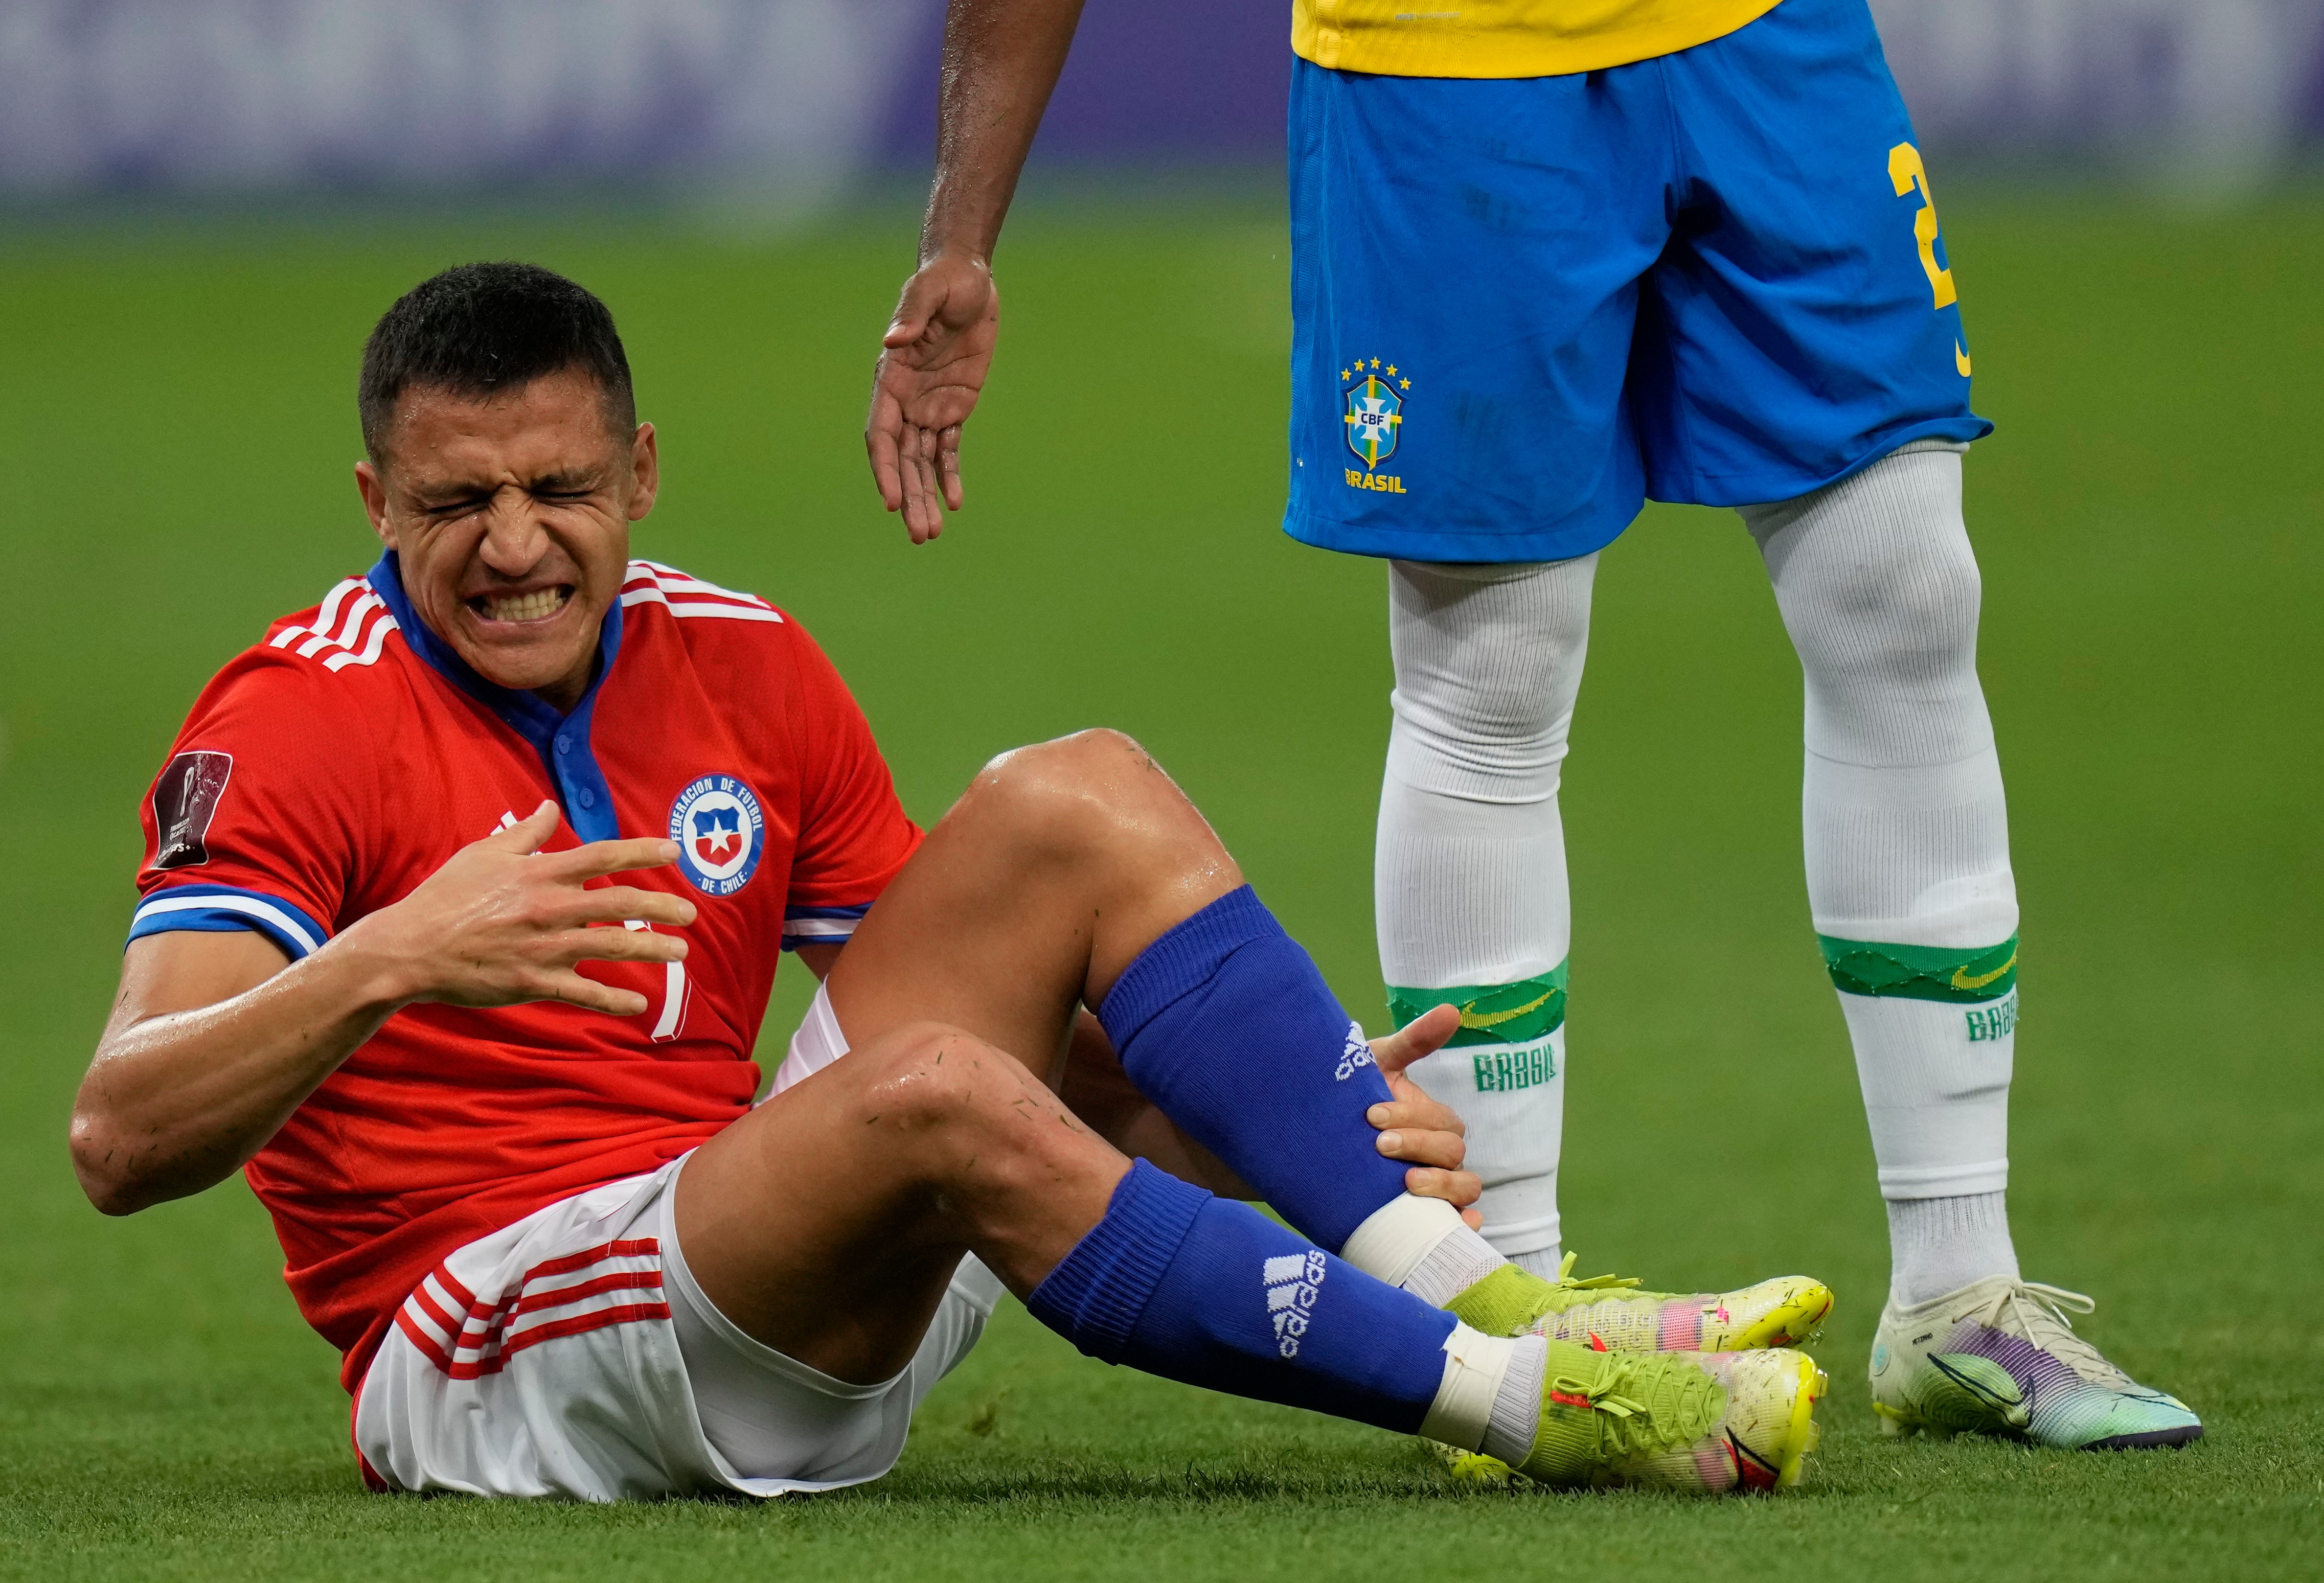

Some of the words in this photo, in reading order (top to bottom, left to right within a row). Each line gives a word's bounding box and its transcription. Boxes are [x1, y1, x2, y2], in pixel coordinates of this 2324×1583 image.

[1361, 413, 1384, 426] CBF
[1345, 468, 1407, 494] BRASIL
[671, 778, 713, 841] FEDERACION
[720, 777, 736, 793] DE
[737, 787, 763, 832] FUTBOL
[702, 877, 715, 893] DE
[720, 871, 747, 895] CHILE
[1473, 1043, 1556, 1092] BRASIL
[1279, 1250, 1326, 1359] adidas
